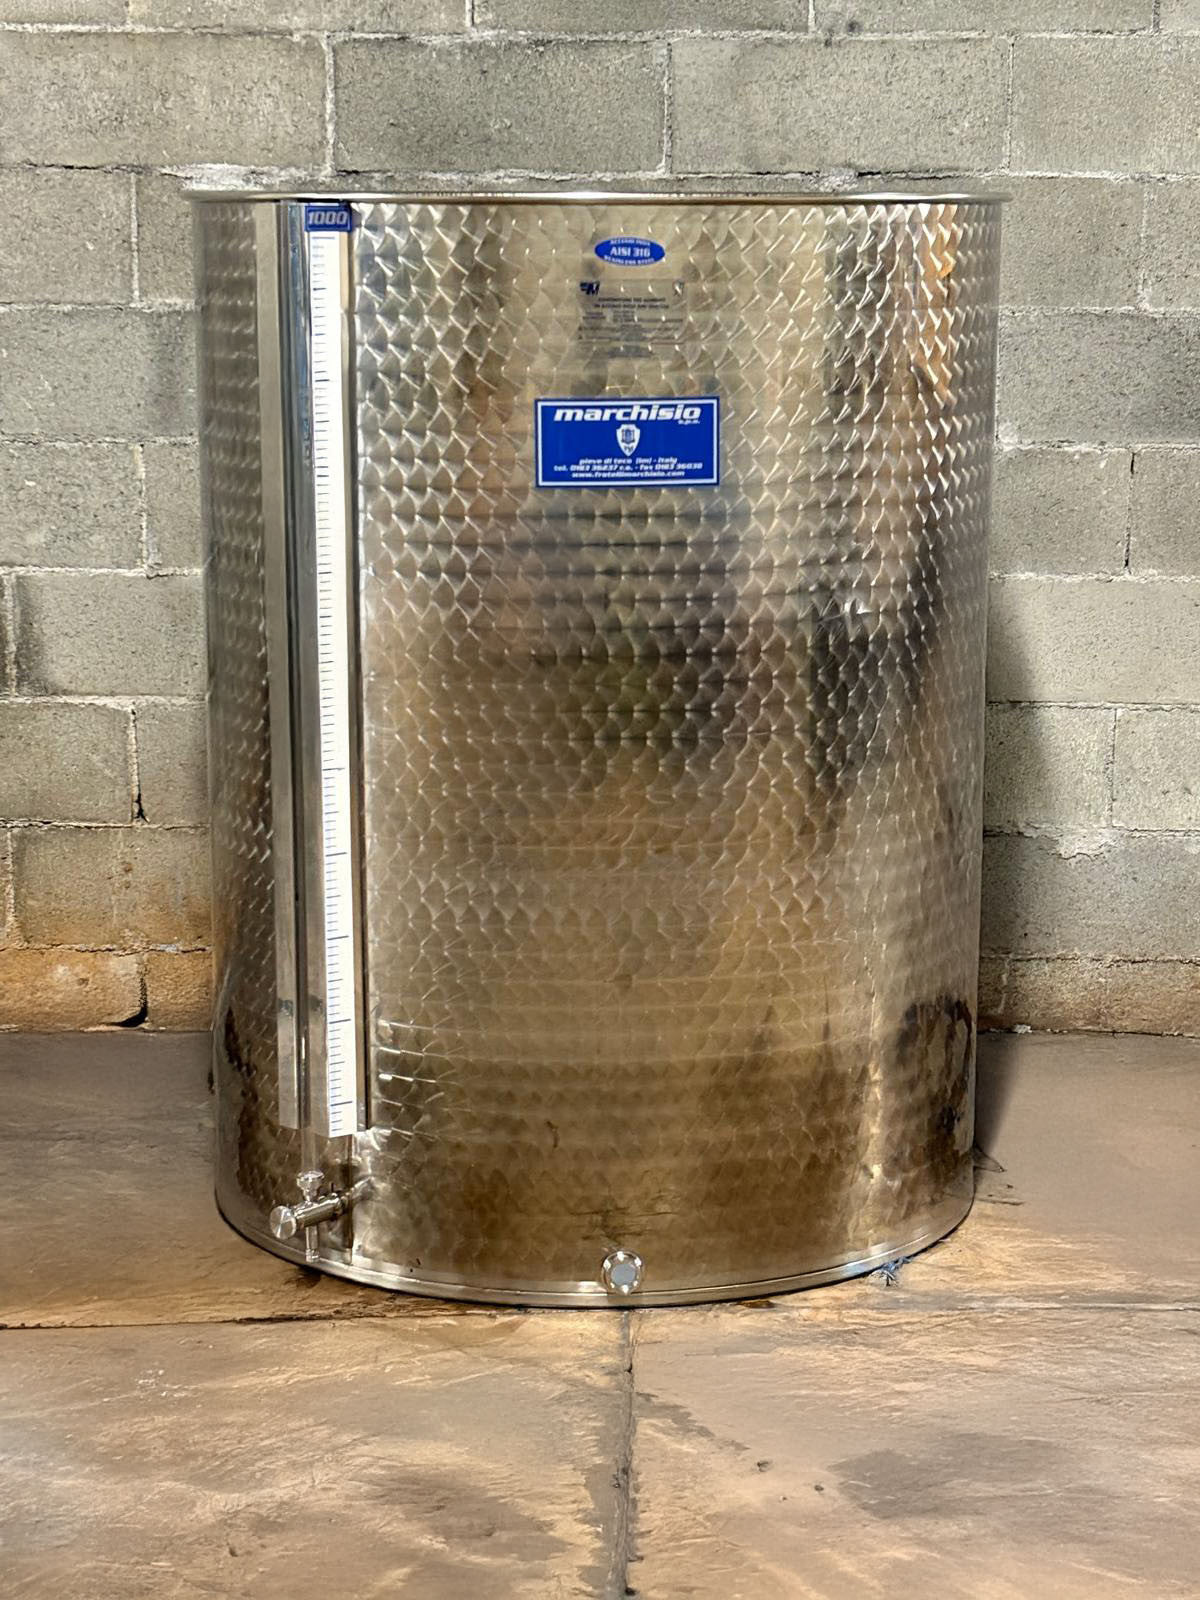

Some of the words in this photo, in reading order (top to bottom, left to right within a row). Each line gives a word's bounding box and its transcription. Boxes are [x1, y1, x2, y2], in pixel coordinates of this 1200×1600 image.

[308, 211, 349, 225] 1000
[609, 246, 631, 256] AISI
[554, 404, 701, 422] marchisio
